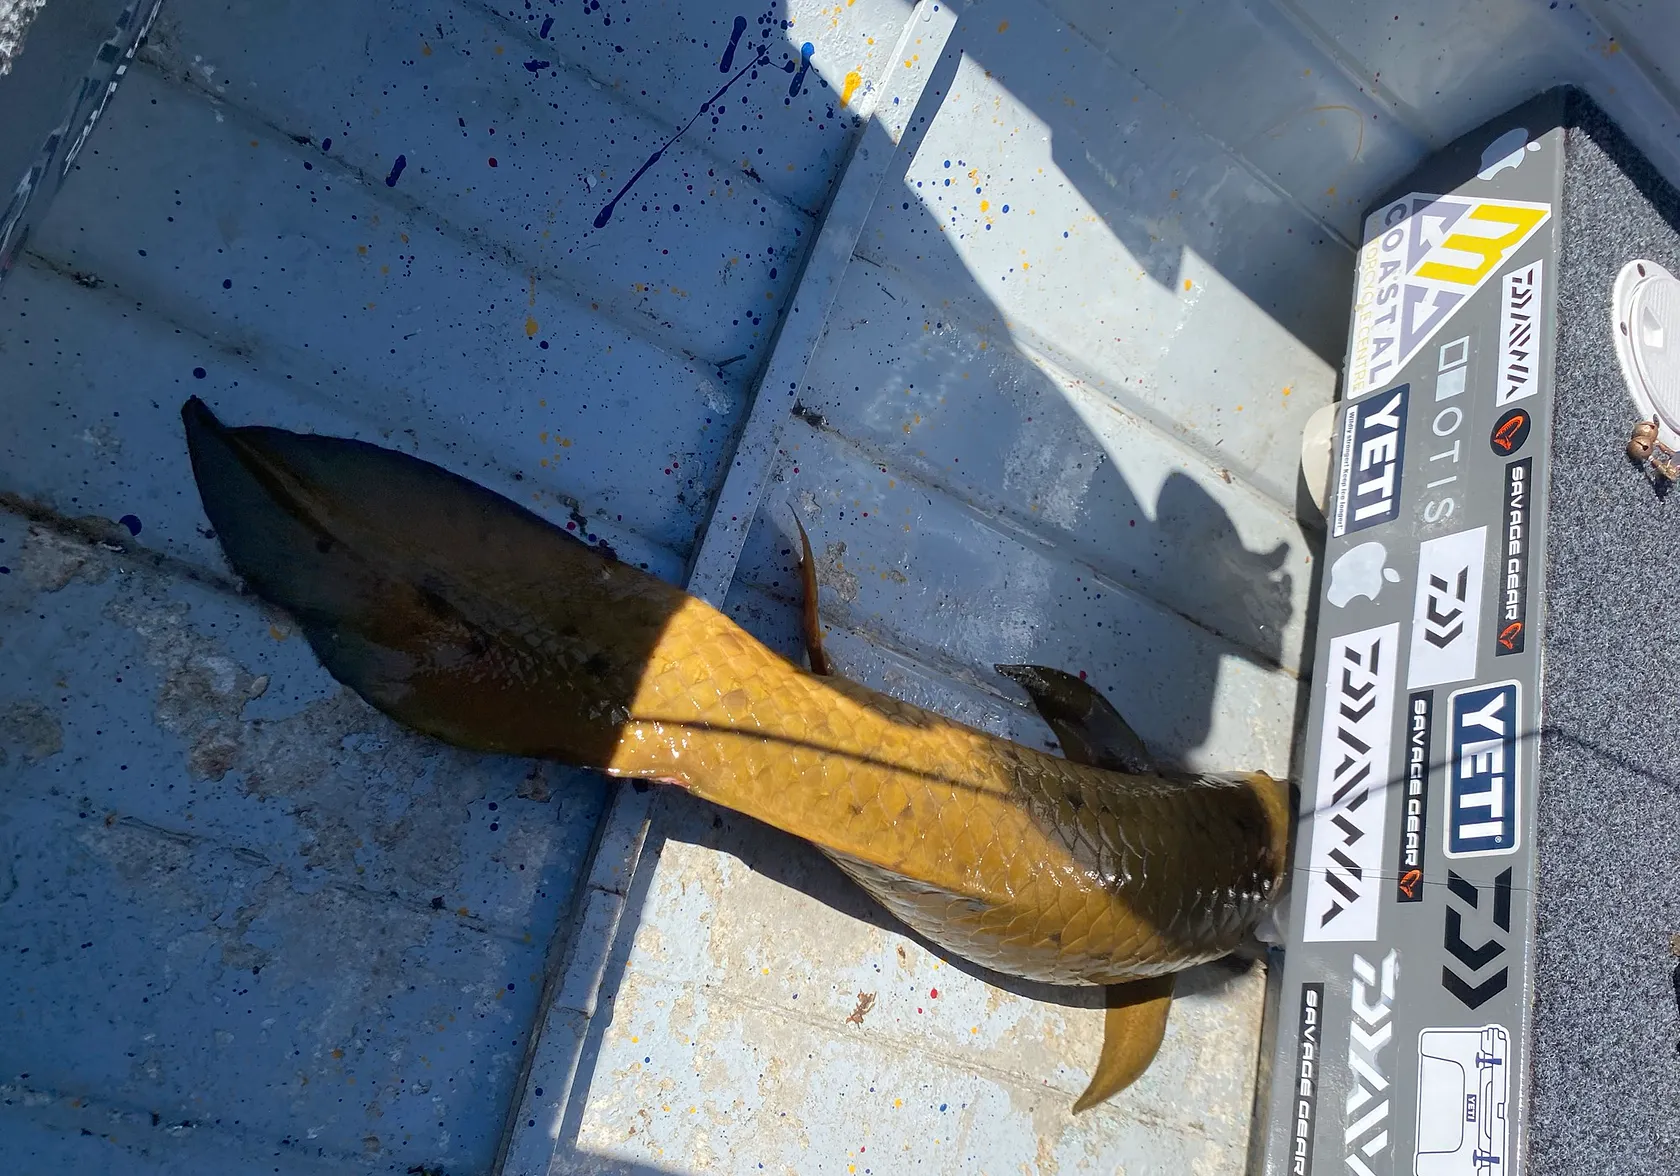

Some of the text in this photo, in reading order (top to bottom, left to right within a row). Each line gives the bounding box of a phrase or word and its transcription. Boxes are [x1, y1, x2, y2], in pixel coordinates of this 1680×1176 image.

[1353, 326, 1372, 392] CENTRE
[1368, 203, 1407, 385] COASTAL
[1354, 392, 1402, 522] YETI
[1424, 406, 1463, 523] OTIS
[1505, 466, 1524, 621] SAVAGE GEAR
[1404, 698, 1428, 867] SAVAGE GEAR
[1458, 691, 1505, 840] YETI
[1294, 989, 1319, 1176] SAVAGE GEAR
[1467, 1096, 1476, 1120] YETI
